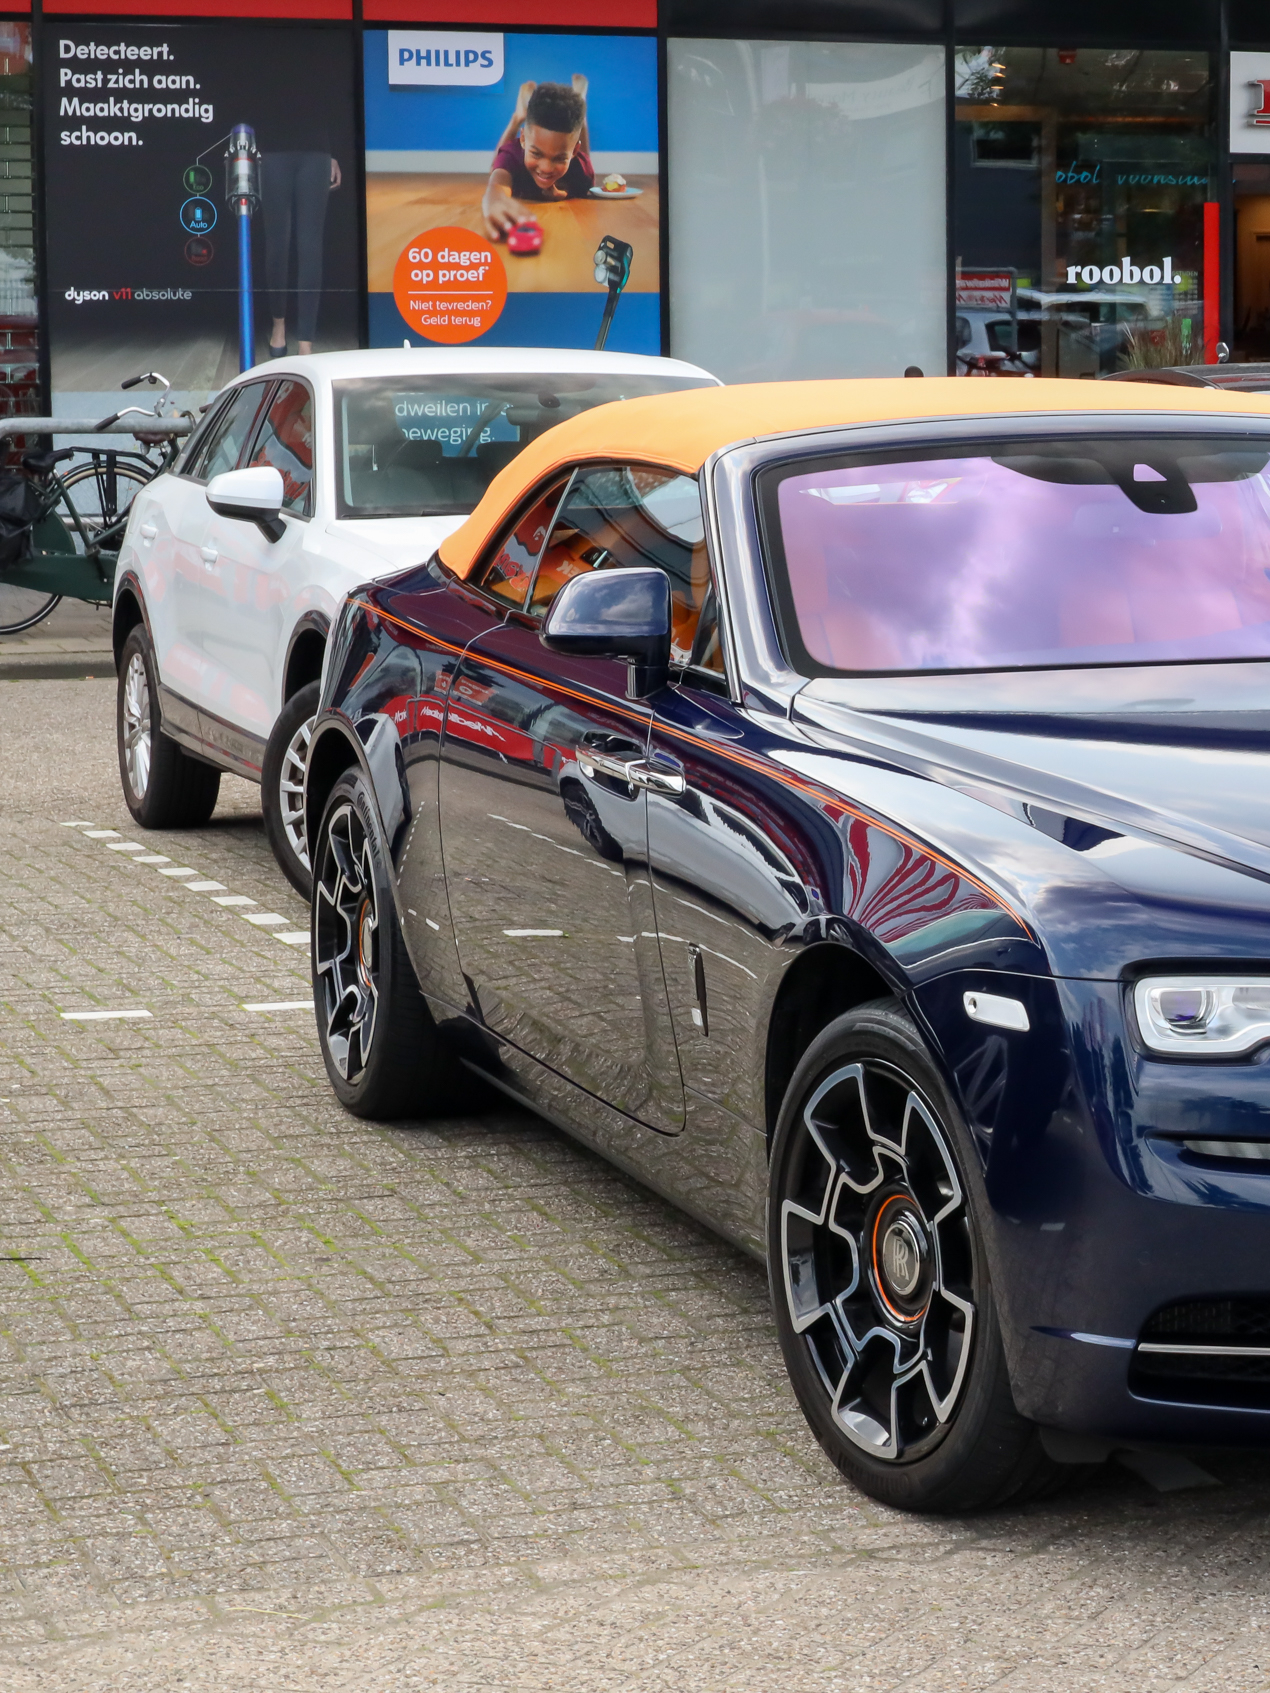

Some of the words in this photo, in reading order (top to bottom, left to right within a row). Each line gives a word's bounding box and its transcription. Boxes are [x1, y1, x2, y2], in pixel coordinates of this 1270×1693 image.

[59, 40, 174, 61] Detecteert.
[398, 48, 494, 69] PHILIPS
[59, 69, 103, 88] Past
[107, 69, 148, 89] zich
[153, 75, 201, 90] aan.
[60, 125, 144, 146] schoon.
[189, 220, 208, 229] Auto
[408, 248, 433, 263] 60
[437, 248, 492, 267] dagen
[410, 269, 434, 284] op
[1066, 256, 1182, 285] roobol.
[65, 287, 109, 304] dyson
[113, 288, 131, 300] v11
[134, 287, 192, 300] absolute
[410, 300, 433, 310] Niet
[436, 300, 492, 311] tevreden?
[421, 314, 448, 325] Geld
[451, 315, 481, 327] terug
[395, 401, 470, 417] dweilen
